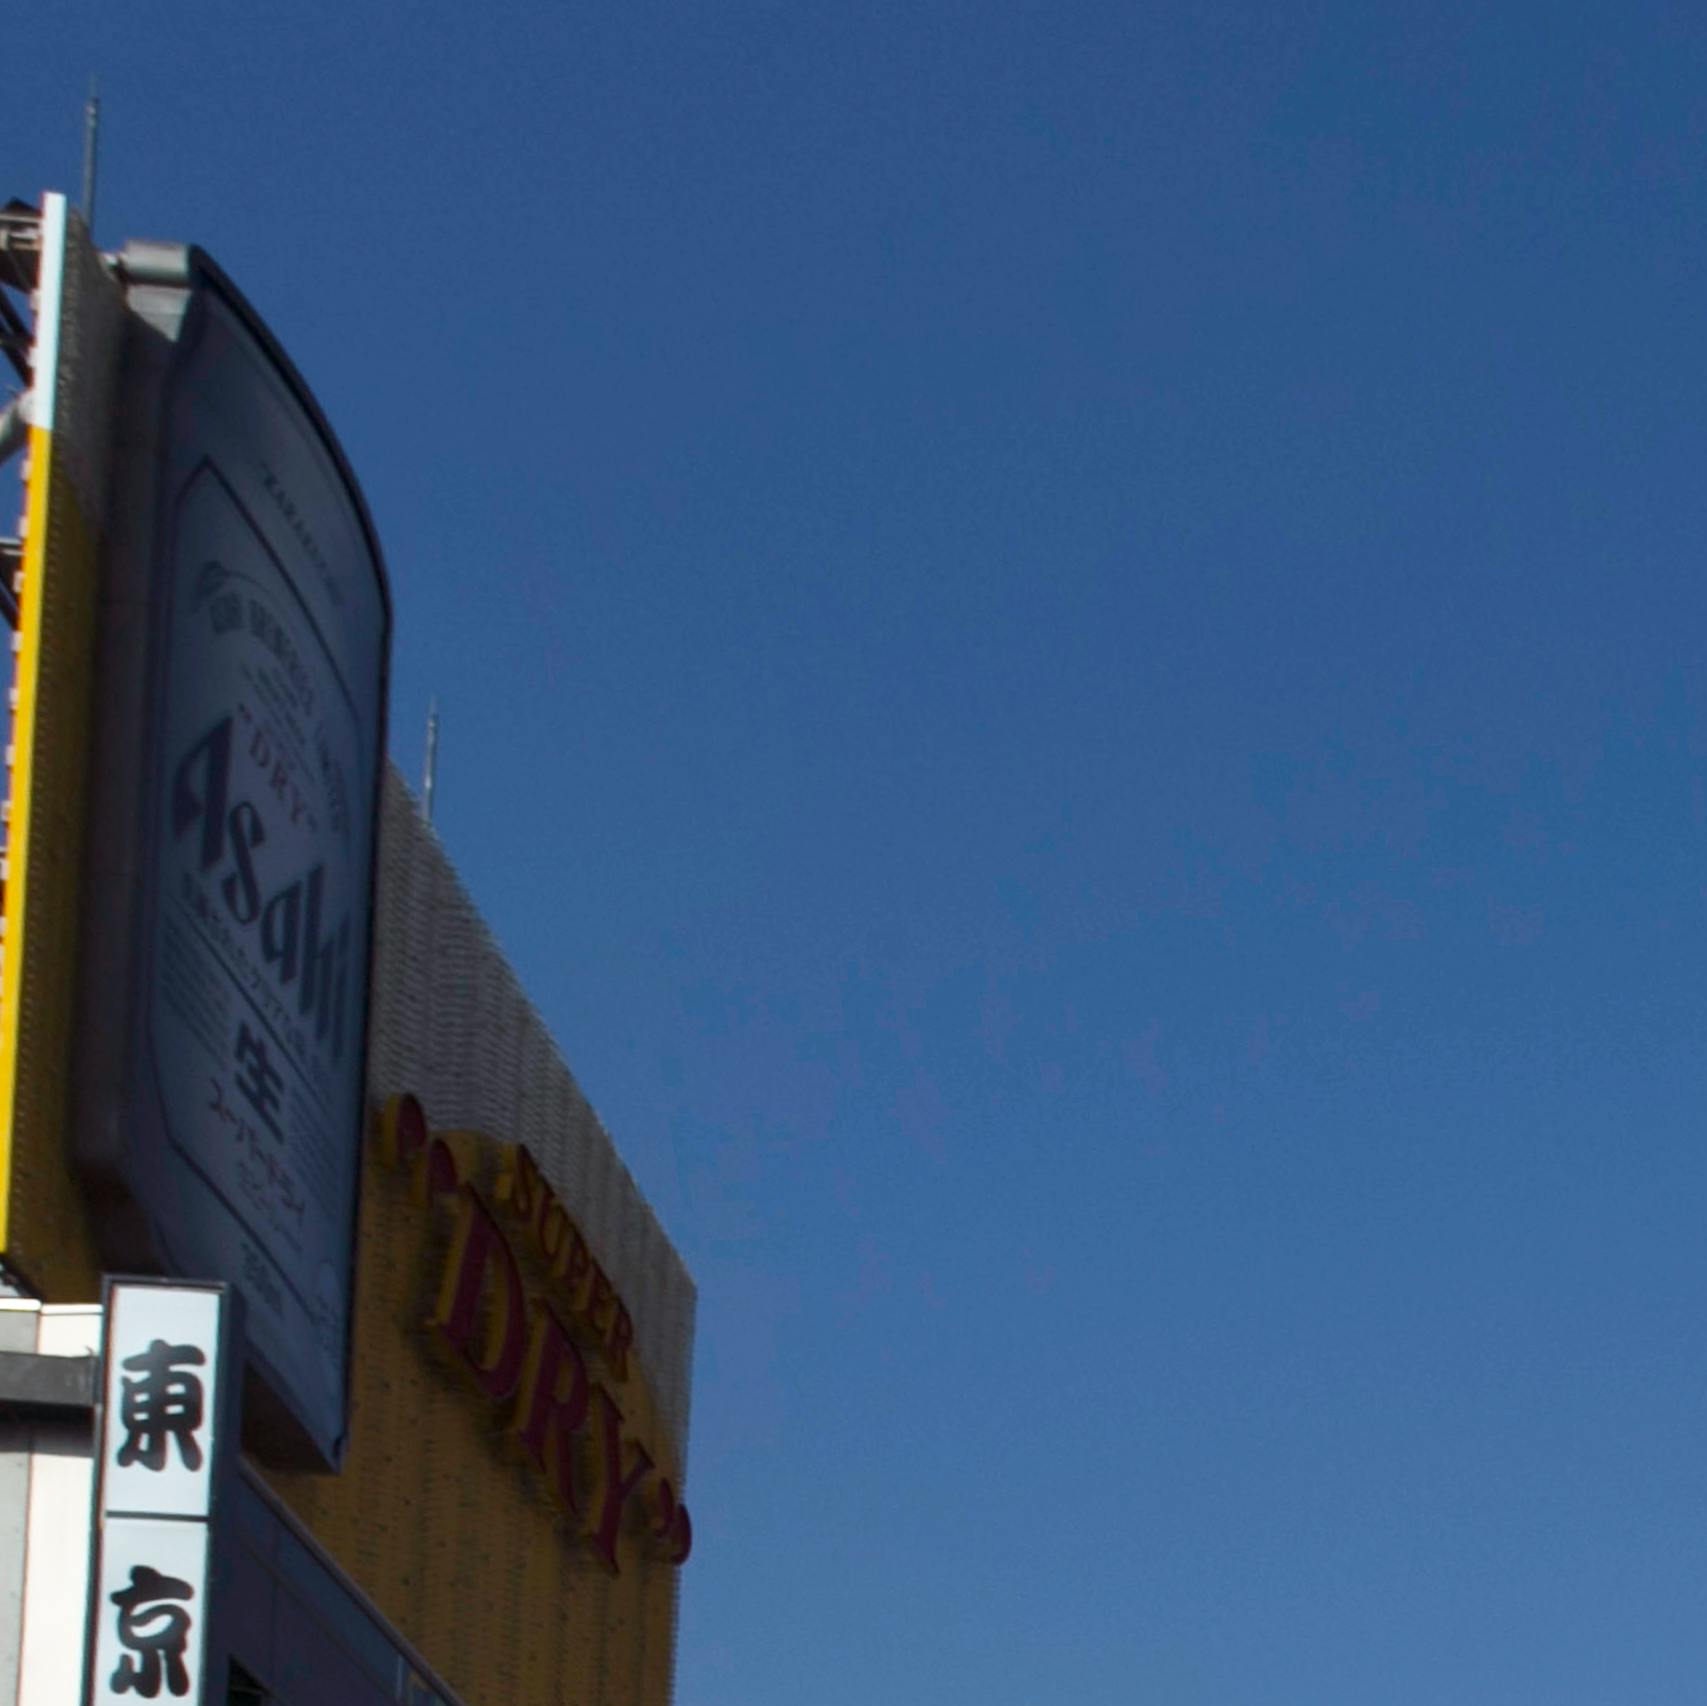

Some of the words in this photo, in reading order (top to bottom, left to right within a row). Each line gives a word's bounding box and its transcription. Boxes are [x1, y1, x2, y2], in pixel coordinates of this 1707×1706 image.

[172, 714, 349, 1066] Asahi
[234, 1020, 285, 1146] 生
[510, 1143, 634, 1383] SUPER
